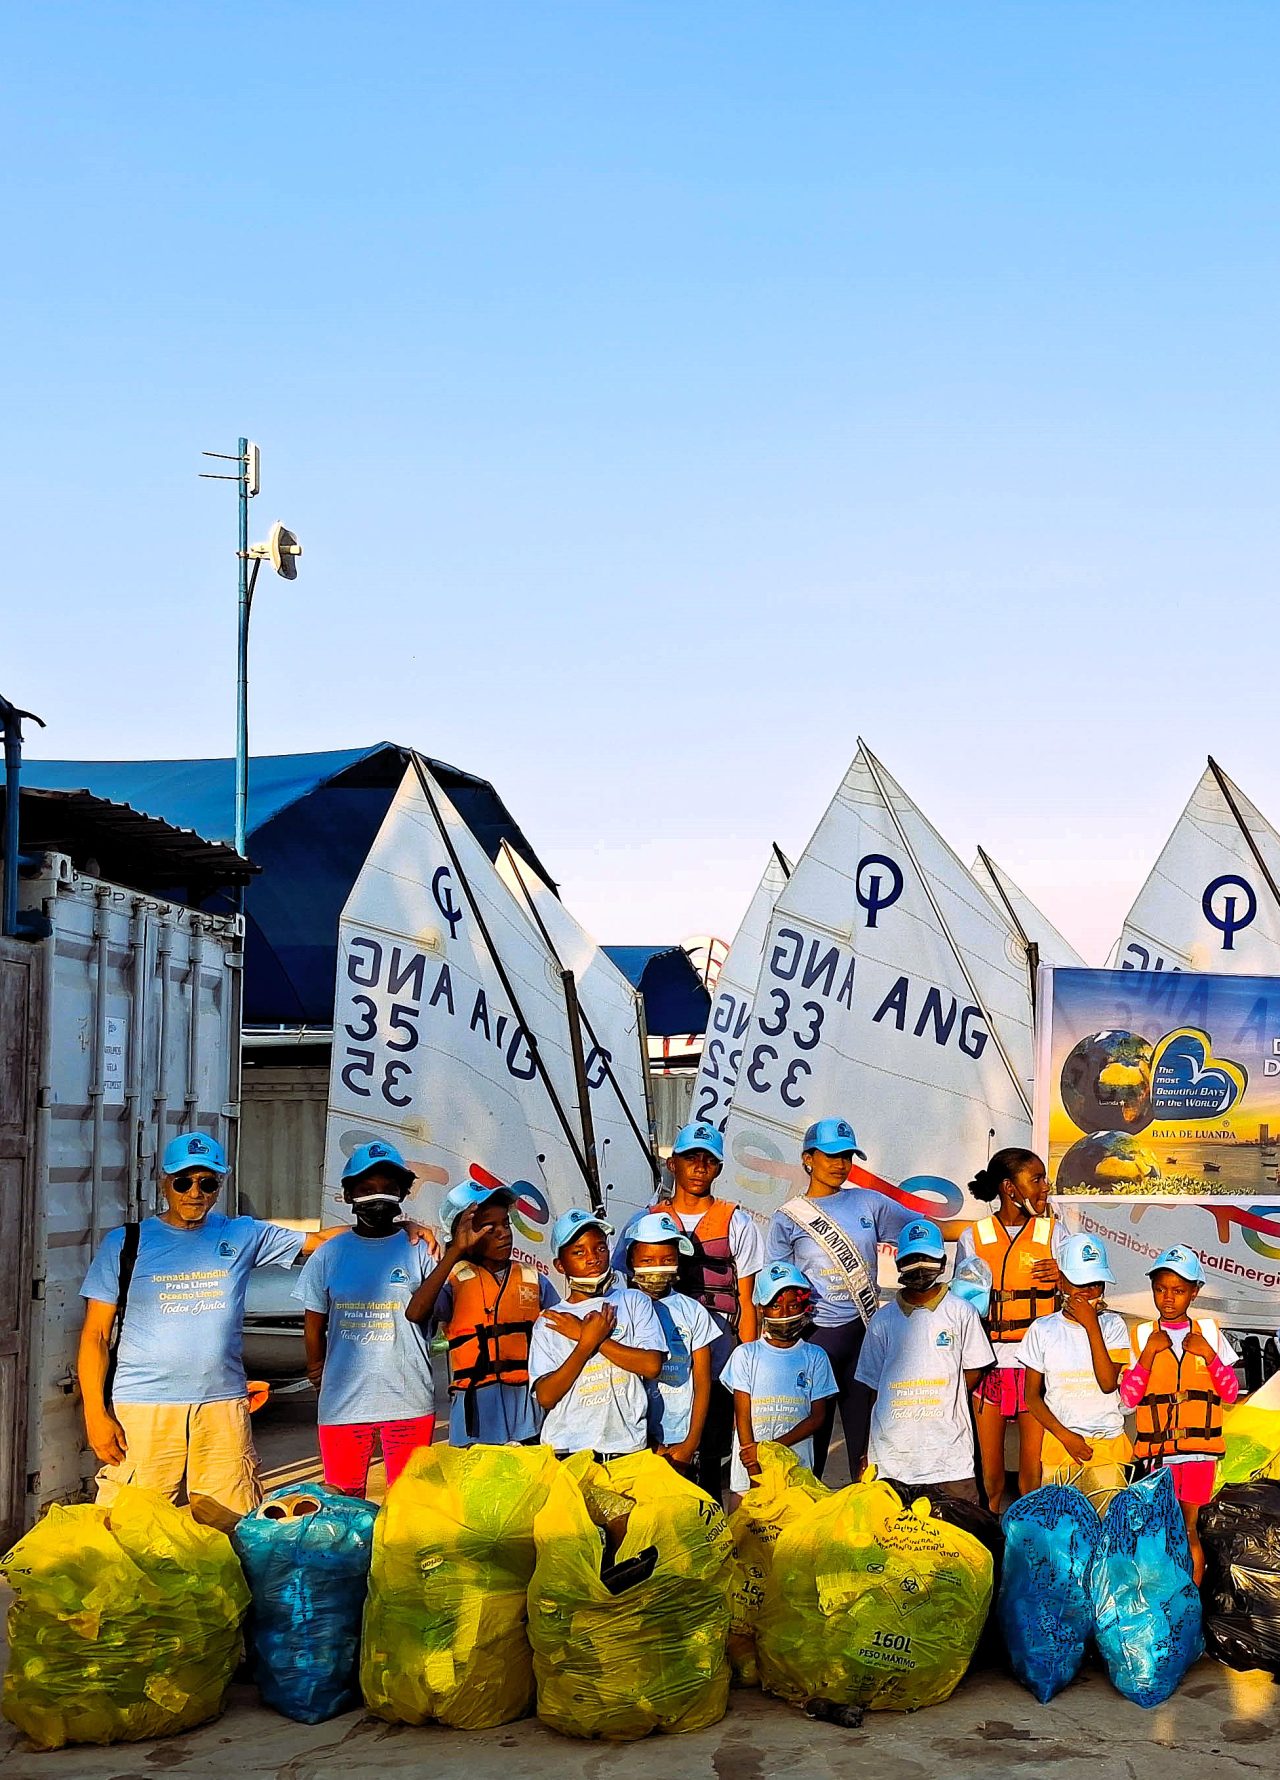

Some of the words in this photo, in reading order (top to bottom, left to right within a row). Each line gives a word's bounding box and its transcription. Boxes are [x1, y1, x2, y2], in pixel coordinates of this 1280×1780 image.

[344, 994, 420, 1053] 35
[758, 987, 825, 1050] 33
[871, 976, 993, 1060] ANG
[1158, 1066, 1174, 1074] The
[1156, 1087, 1198, 1096] Beautiful
[1167, 1099, 1182, 1107] the
[1185, 1099, 1219, 1108] WORLD
[1179, 1130, 1193, 1139] DE
[1195, 1130, 1236, 1139] LUANDA
[808, 1216, 832, 1236] MISS
[152, 1273, 190, 1283] Jornada
[191, 1269, 229, 1280] Mundial
[166, 1282, 189, 1290] Praia
[191, 1280, 219, 1289] Limpa
[159, 1292, 194, 1300] Oceano
[196, 1289, 224, 1298] Limpo
[160, 1302, 189, 1314] Todos
[191, 1300, 226, 1316] Juntos
[872, 1630, 913, 1653] 160L
[859, 1648, 880, 1661] PESO
